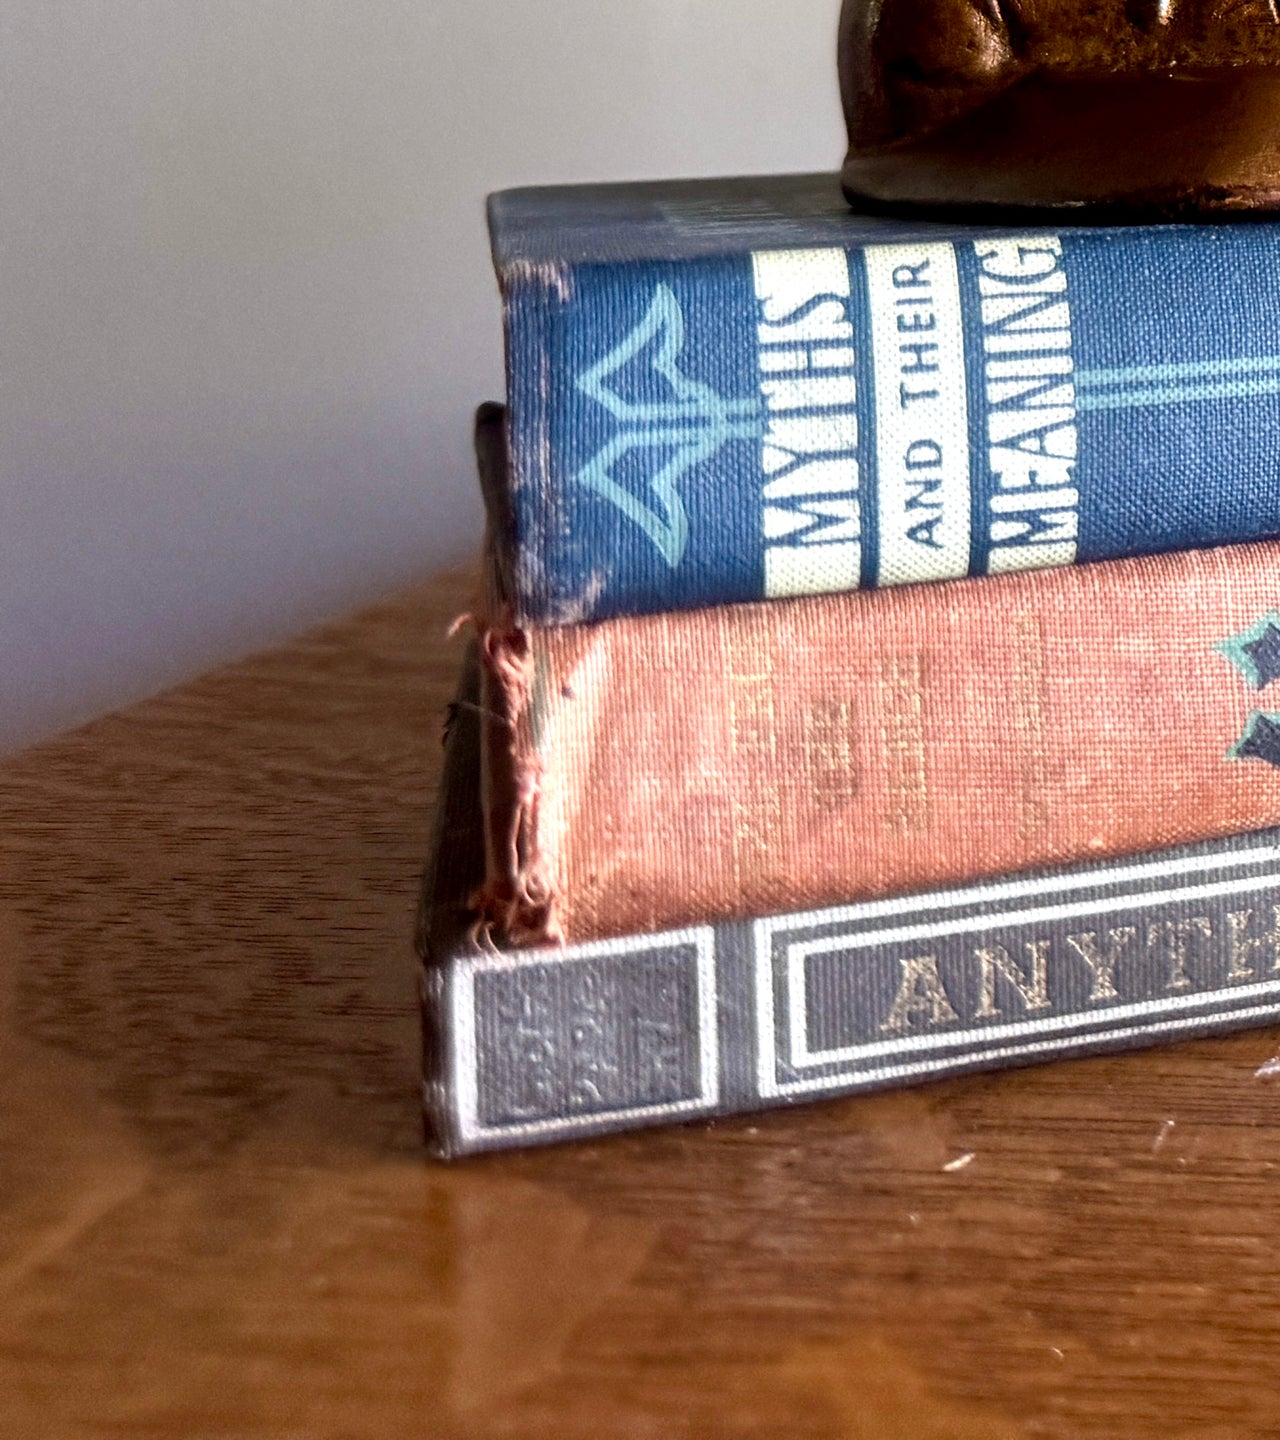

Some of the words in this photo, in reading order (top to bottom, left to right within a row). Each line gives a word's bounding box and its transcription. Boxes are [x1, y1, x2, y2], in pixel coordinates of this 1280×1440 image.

[756, 292, 862, 548] MYTHS
[892, 257, 940, 410] THEIR
[976, 244, 1079, 550] MEANING
[904, 437, 944, 550] AND
